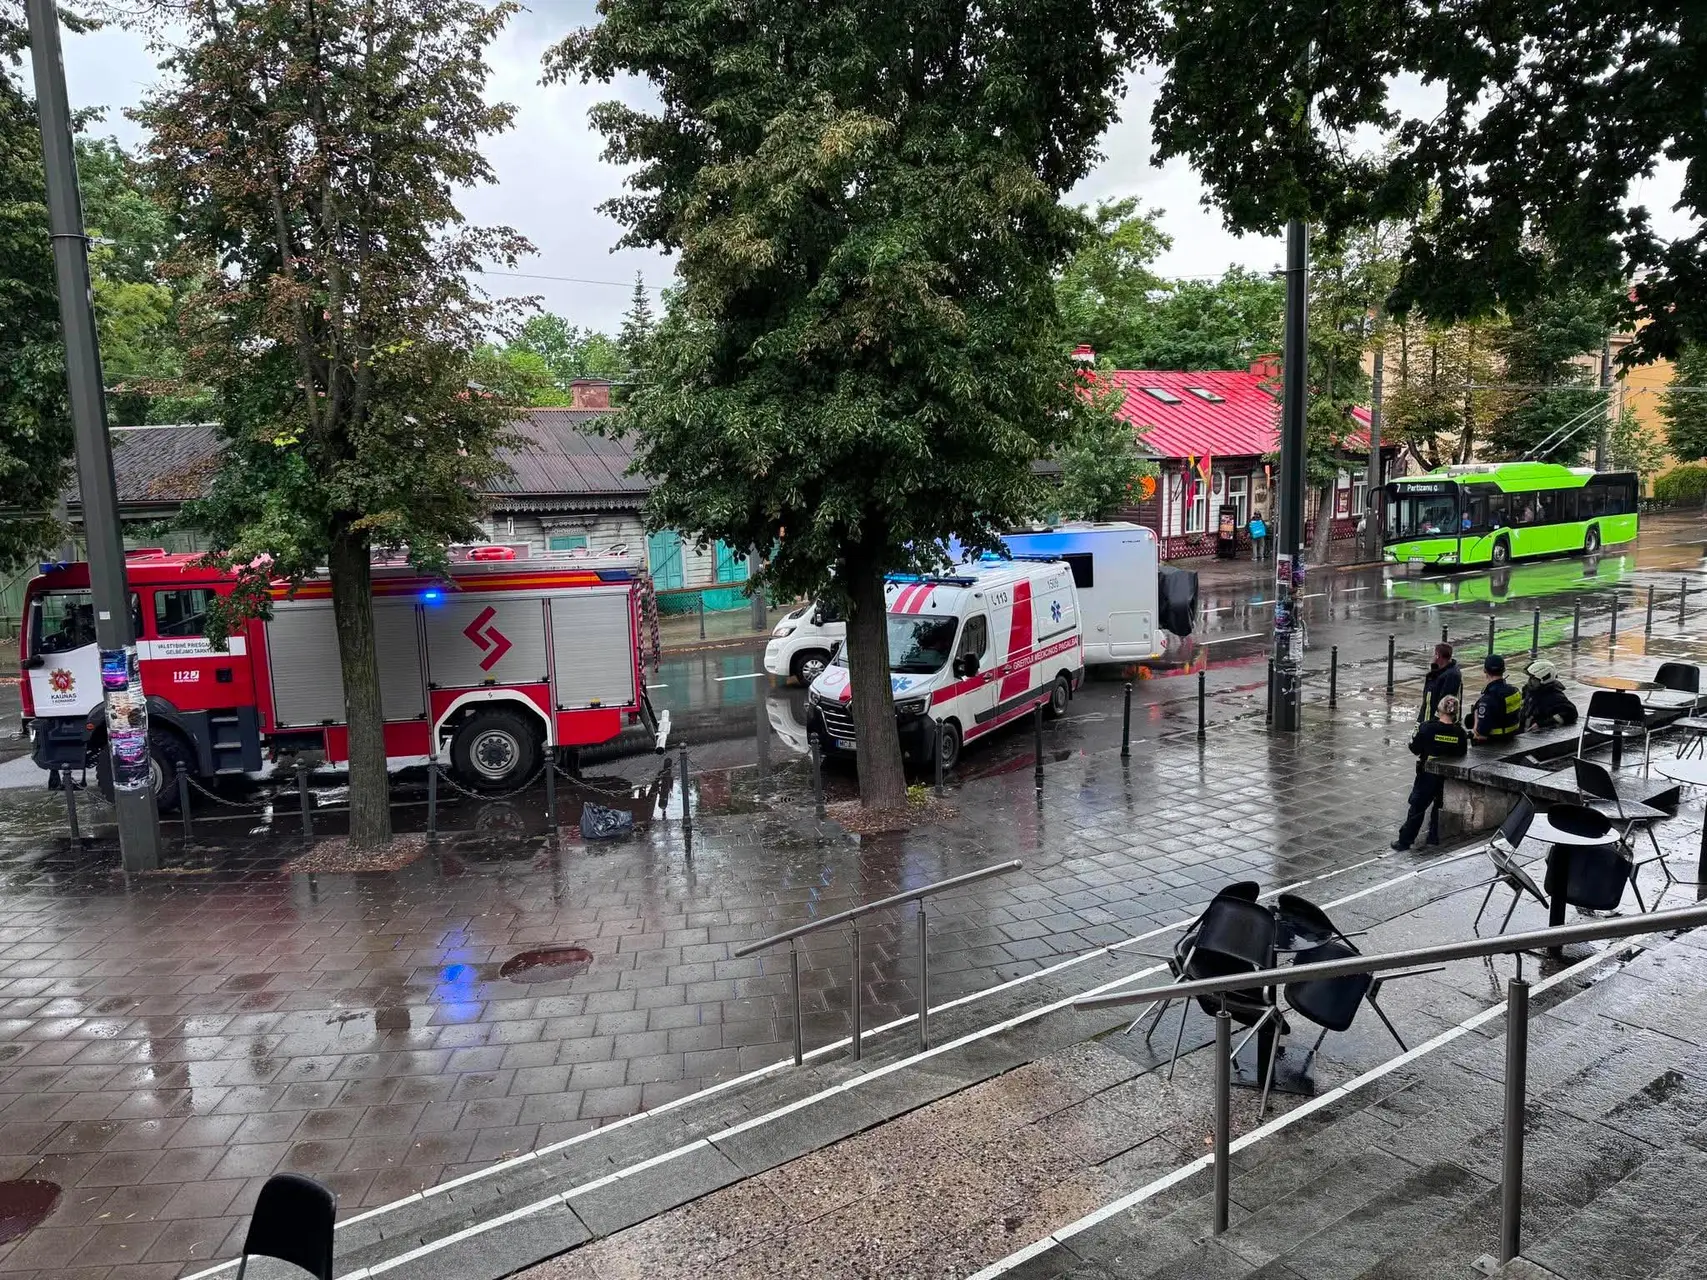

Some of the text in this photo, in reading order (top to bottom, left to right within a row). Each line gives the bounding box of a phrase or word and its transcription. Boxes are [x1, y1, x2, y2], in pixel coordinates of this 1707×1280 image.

[1396, 483, 1401, 493] 7
[996, 591, 1008, 604] 113
[1013, 637, 1078, 670] GREITOJI MEDICINOS PAGALBA
[173, 670, 190, 680] 112
